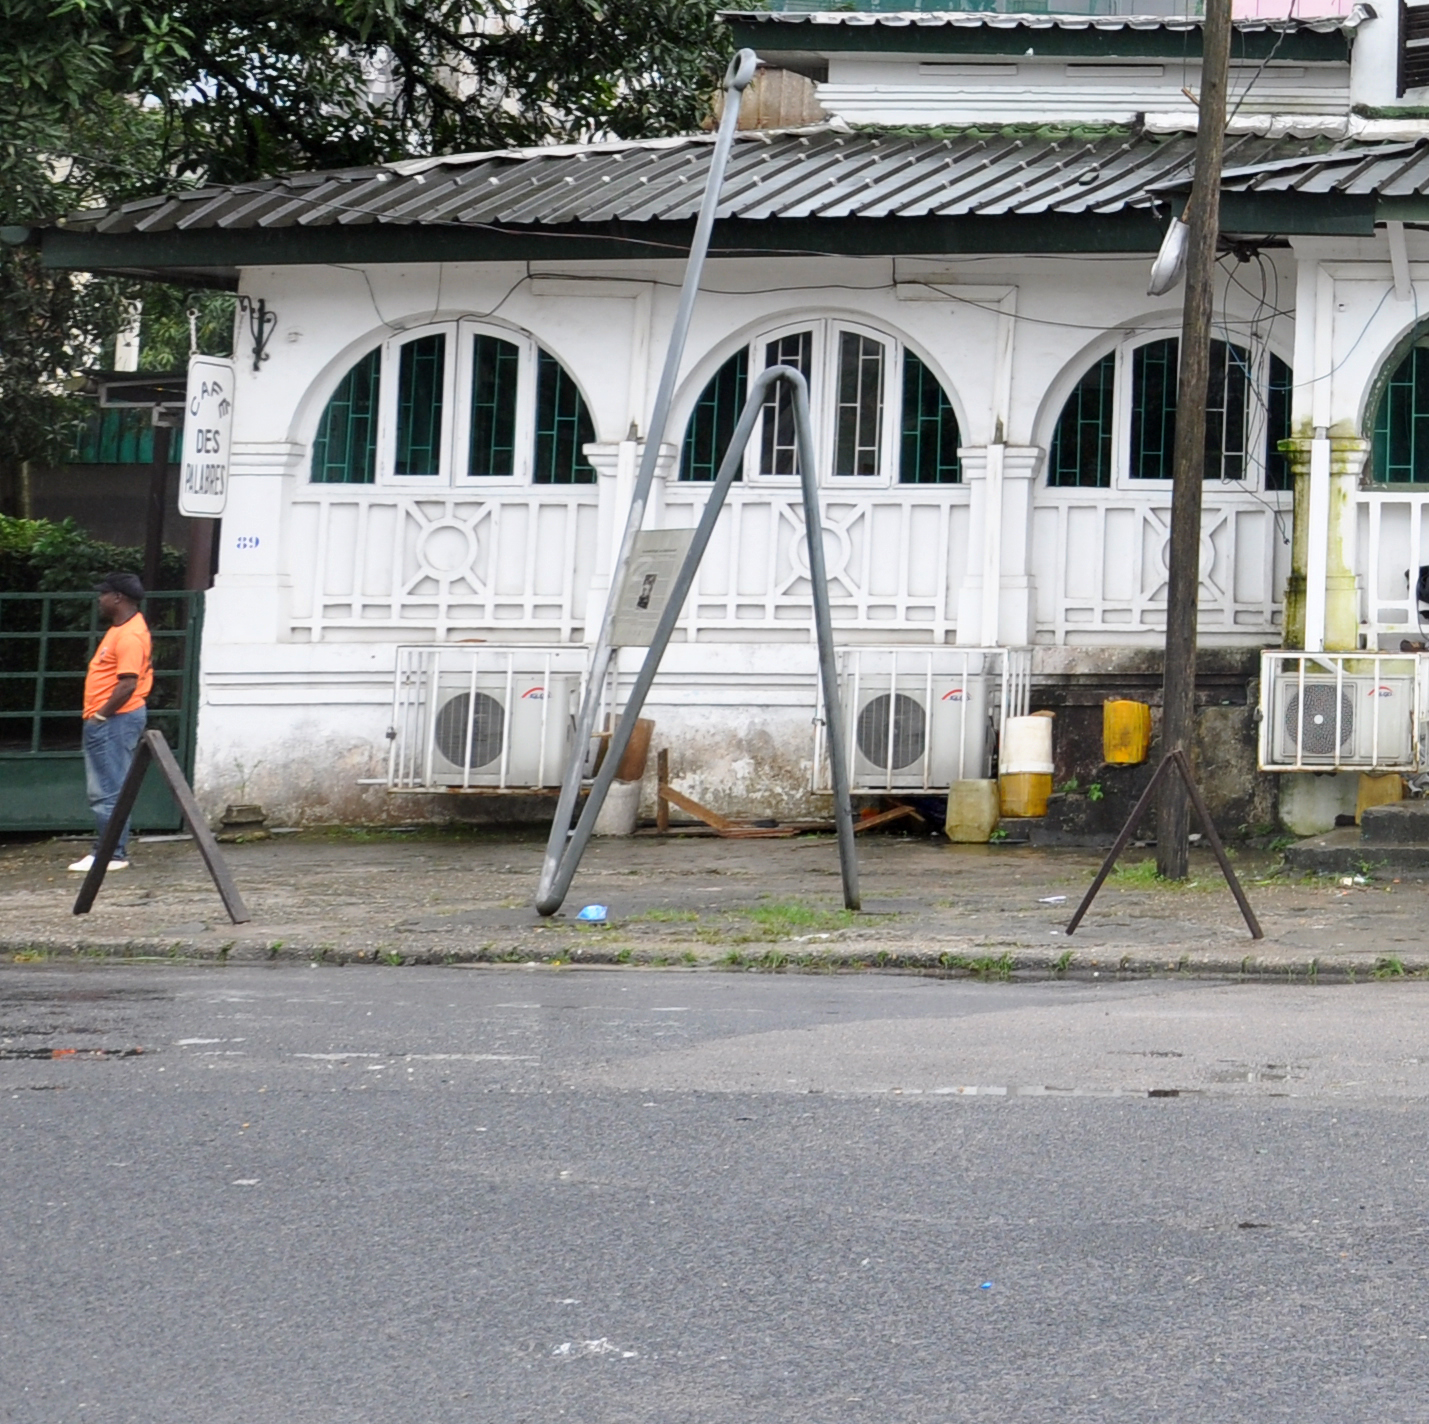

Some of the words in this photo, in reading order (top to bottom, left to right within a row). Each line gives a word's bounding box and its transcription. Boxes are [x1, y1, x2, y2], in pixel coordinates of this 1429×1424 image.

[196, 428, 221, 454] DES
[185, 462, 226, 495] PALABRES
[236, 536, 260, 550] 89
